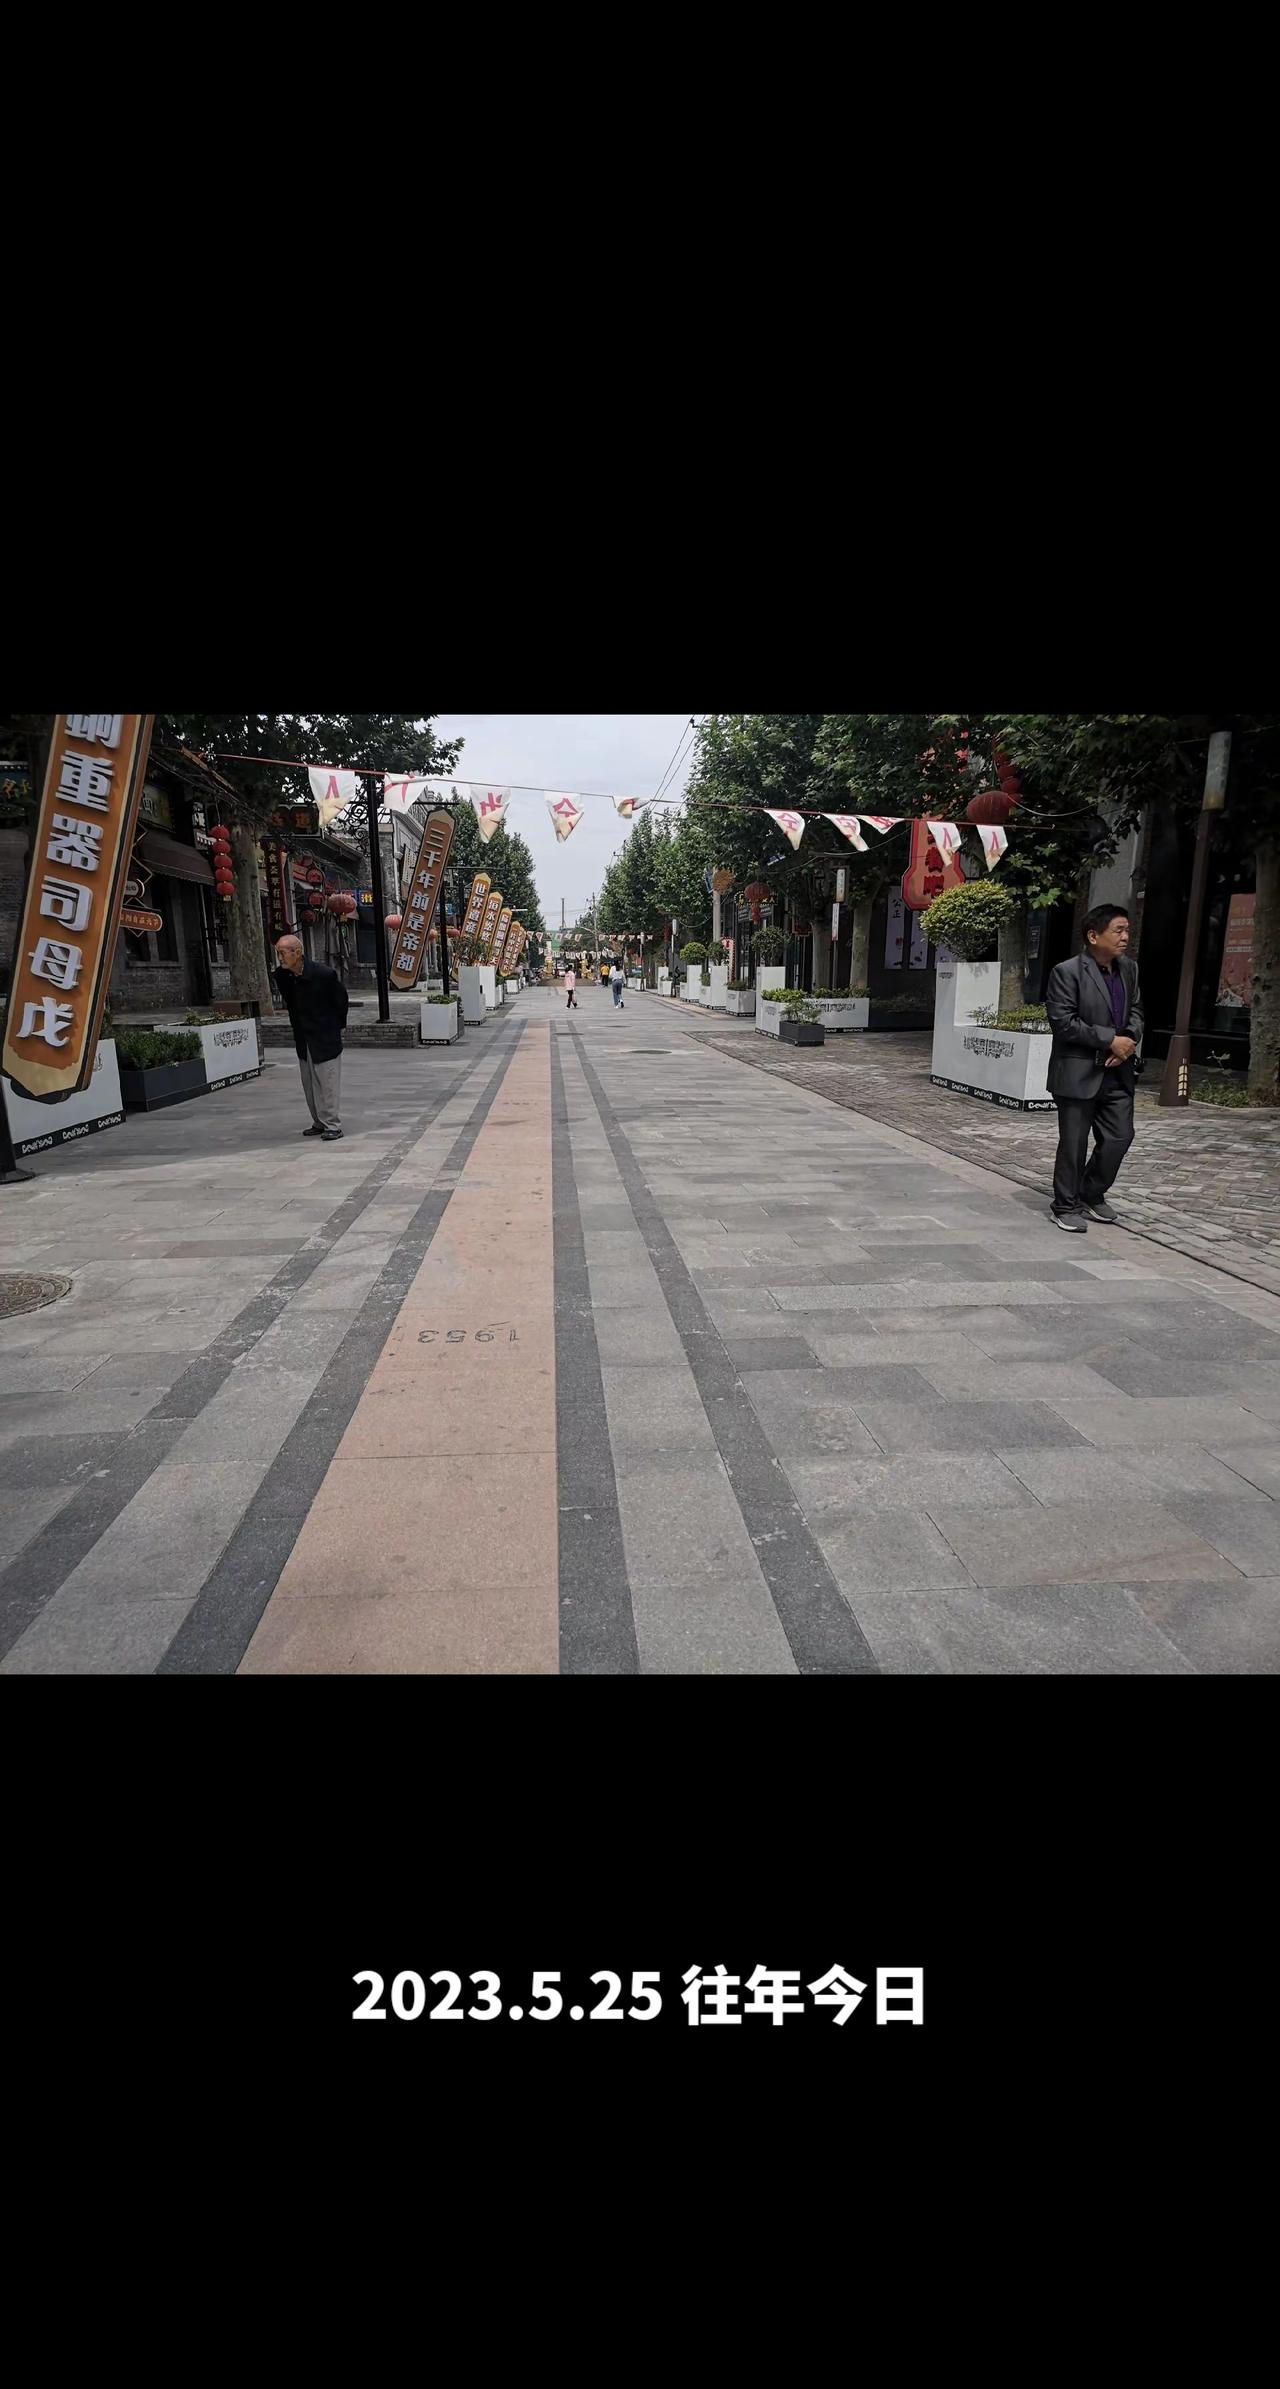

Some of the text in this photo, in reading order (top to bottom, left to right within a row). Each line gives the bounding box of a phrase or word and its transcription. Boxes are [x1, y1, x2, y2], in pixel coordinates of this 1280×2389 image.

[396, 827, 446, 972] 三千年前是帝都
[417, 1328, 521, 1344] 1953
